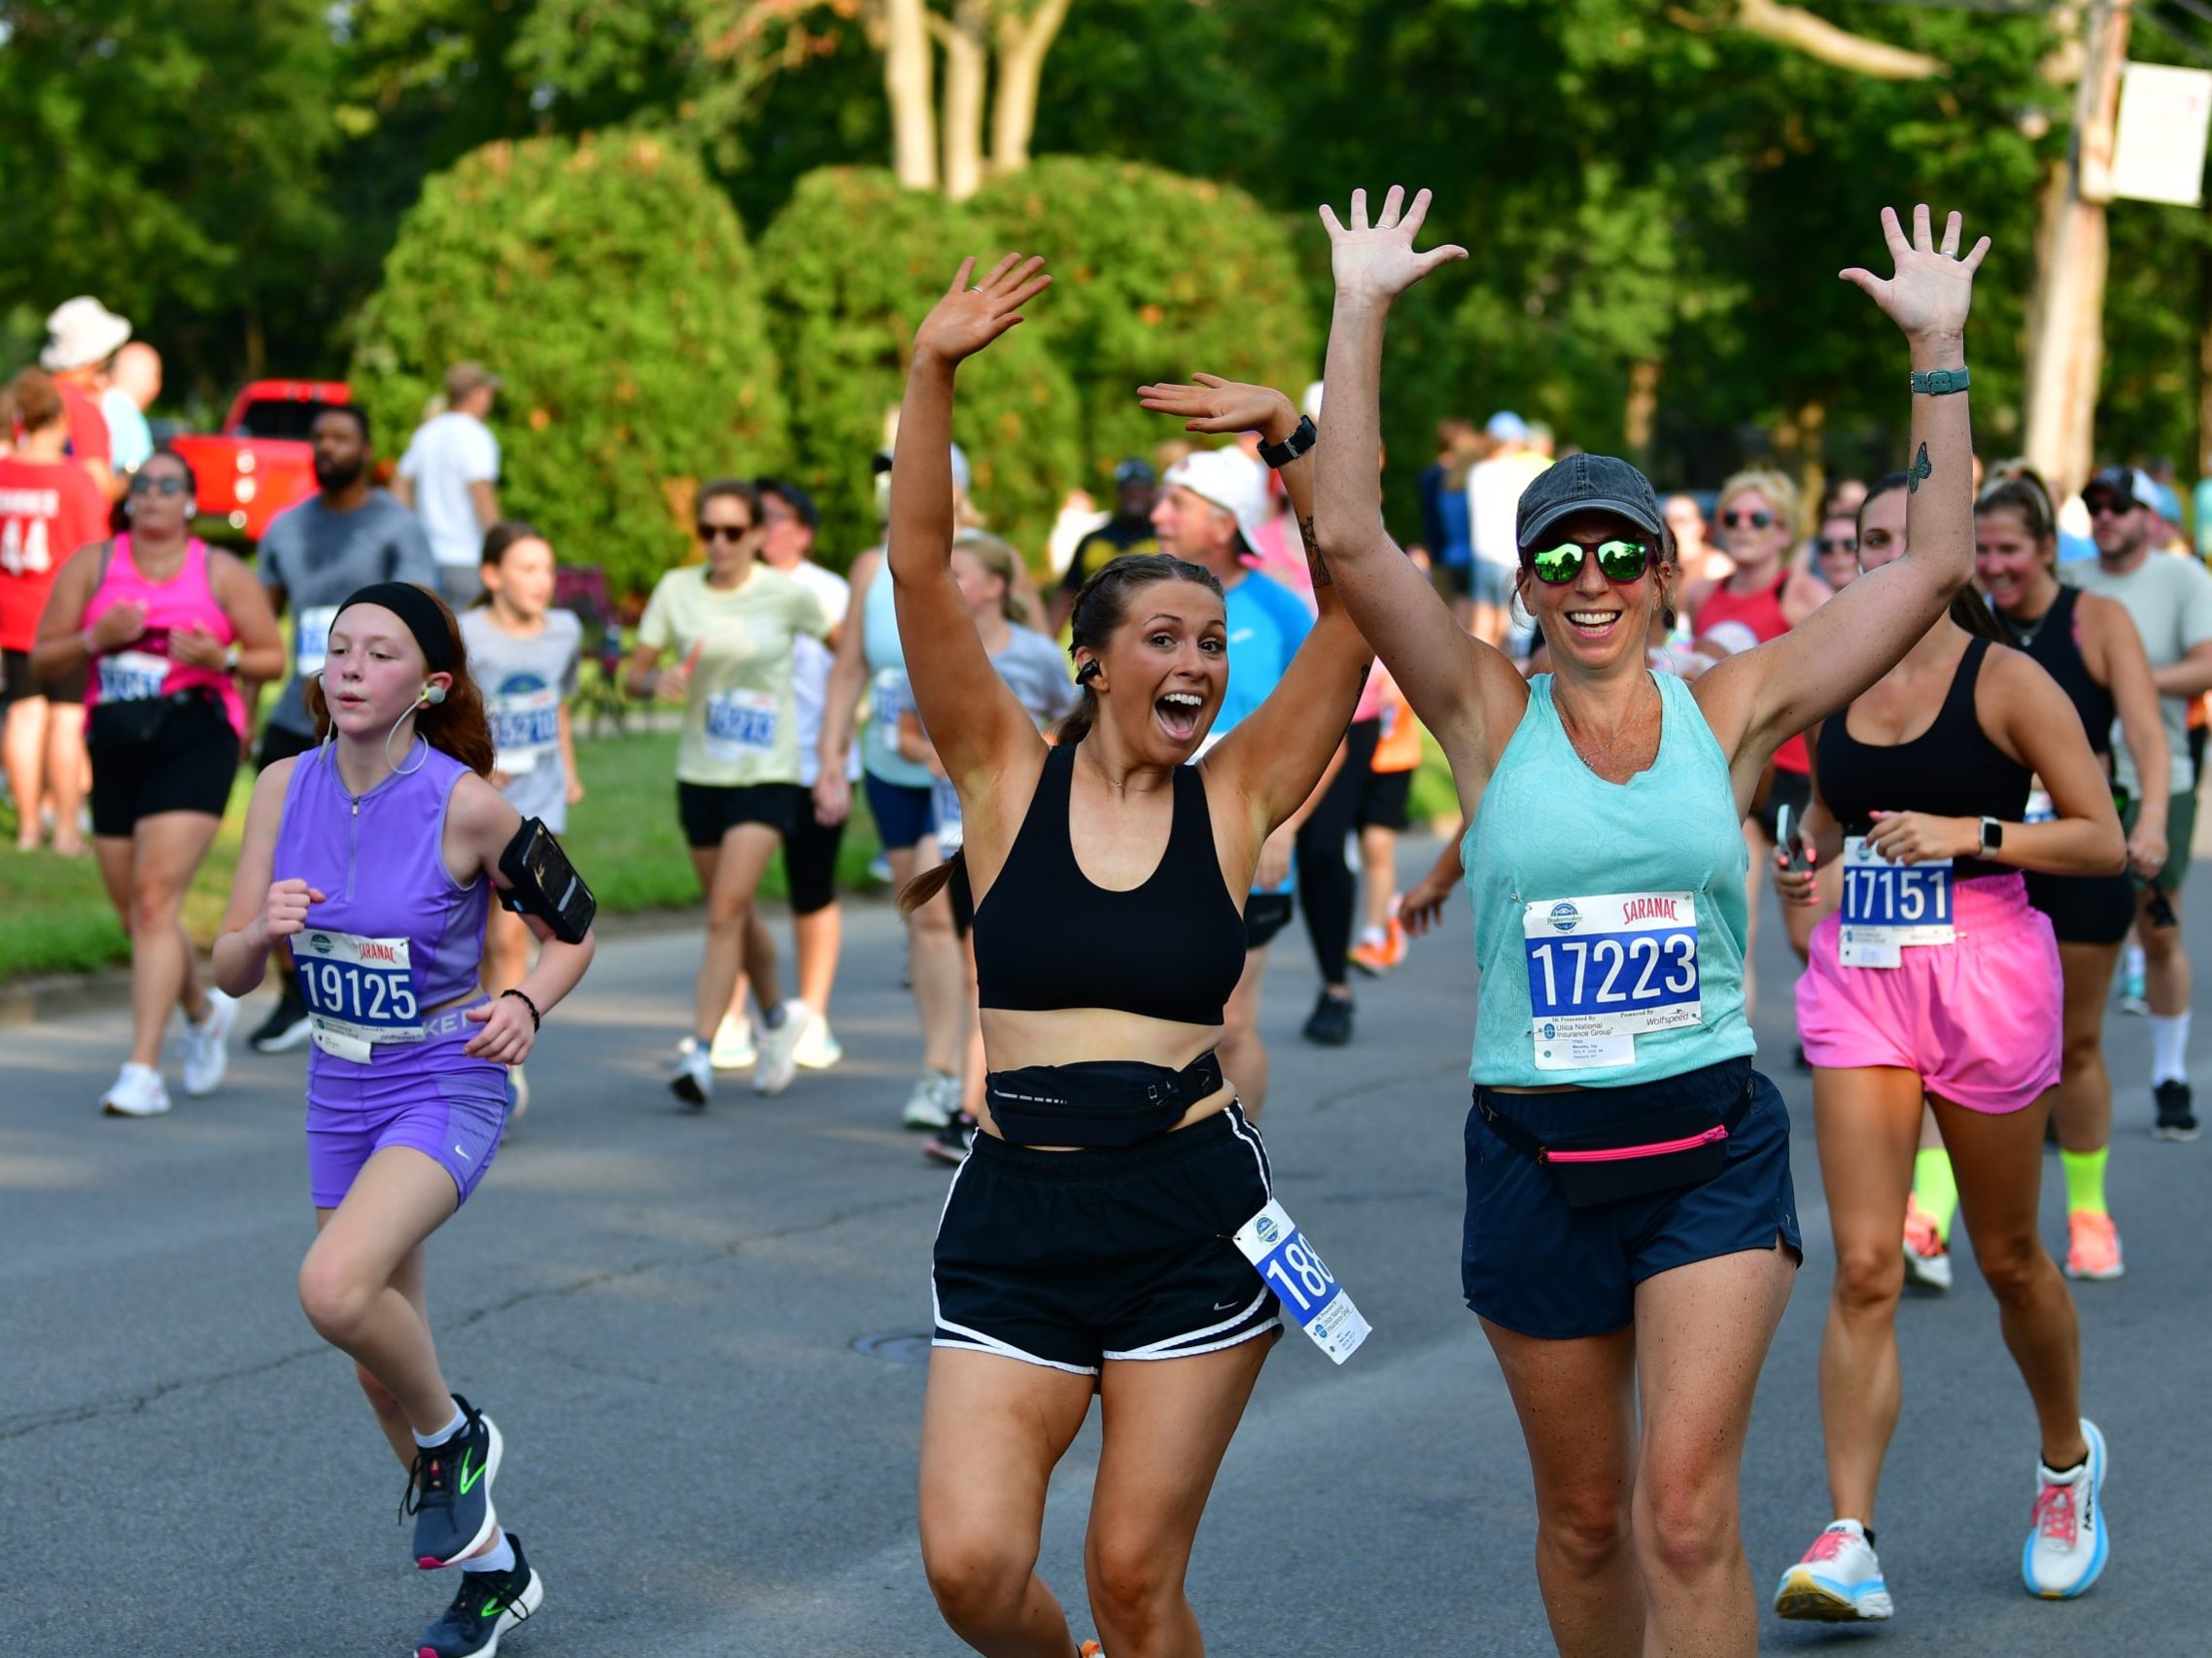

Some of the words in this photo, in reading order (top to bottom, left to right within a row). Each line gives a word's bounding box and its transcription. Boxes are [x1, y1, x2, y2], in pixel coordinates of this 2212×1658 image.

[1845, 869, 1946, 920] 17151
[1623, 897, 1678, 925] SARANAC
[359, 943, 397, 964] SARANAC
[1532, 933, 1697, 1006] 17223
[299, 961, 418, 1020] 19125
[1574, 1021, 1603, 1030] National
[1645, 1013, 1689, 1026] Wolfspeed
